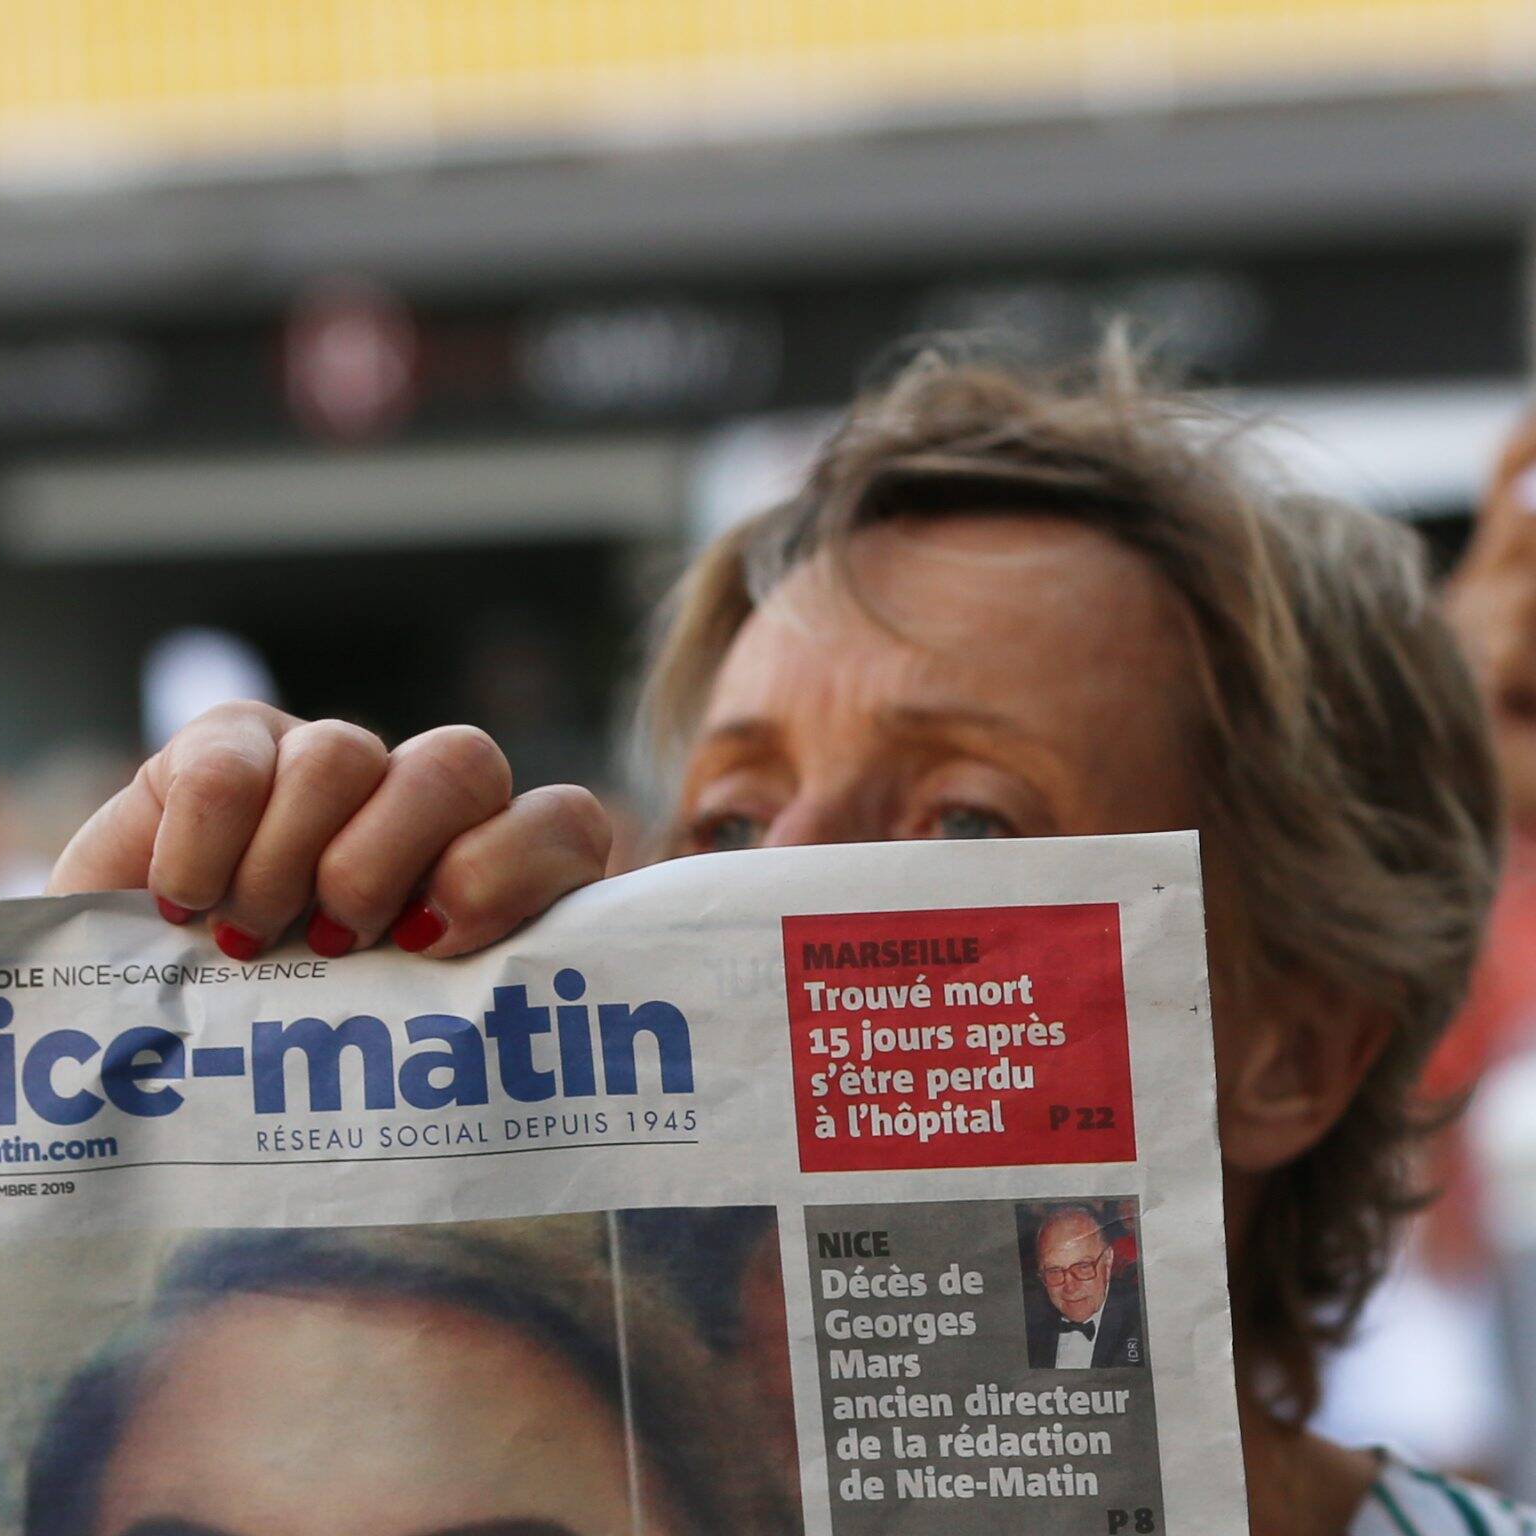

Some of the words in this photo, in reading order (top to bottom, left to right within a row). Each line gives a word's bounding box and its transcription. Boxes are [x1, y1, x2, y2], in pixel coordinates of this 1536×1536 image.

[802, 937, 980, 970] MARSEILLE
[52, 961, 328, 986] NICE-CAGNES-VENCE
[804, 974, 931, 1012] Trouvé
[944, 974, 1033, 1007] mort
[809, 1028, 850, 1058] 15
[861, 1020, 954, 1060] jours
[966, 1013, 1066, 1055] après
[811, 1061, 914, 1097] s'être
[926, 1057, 1034, 1100] perdu
[257, 1124, 364, 1152] RÉSEAU
[380, 1121, 488, 1148] SOCIAL
[505, 1111, 609, 1141] DEPUIS
[626, 1109, 698, 1133] 1945
[815, 1106, 836, 1139] à
[849, 1100, 1005, 1142] l'hôpital
[1049, 1105, 1070, 1131] P
[1076, 1106, 1116, 1130] 22
[40, 1180, 76, 1196] 2019
[817, 1231, 891, 1259] NICE
[821, 1263, 928, 1300] Décès
[938, 1263, 984, 1296] de
[824, 1309, 977, 1345] Georges
[829, 1348, 921, 1380] Mars
[1127, 1337, 1139, 1363] (DR)
[833, 1385, 954, 1420] ancien
[964, 1383, 1130, 1418] directeur
[836, 1427, 882, 1461] de
[892, 1426, 927, 1459] la
[939, 1423, 1112, 1459] rédaction
[839, 1468, 885, 1501] de
[896, 1464, 1099, 1500] Nice-Matin
[1107, 1508, 1129, 1536] P
[1134, 1508, 1156, 1535] 8
